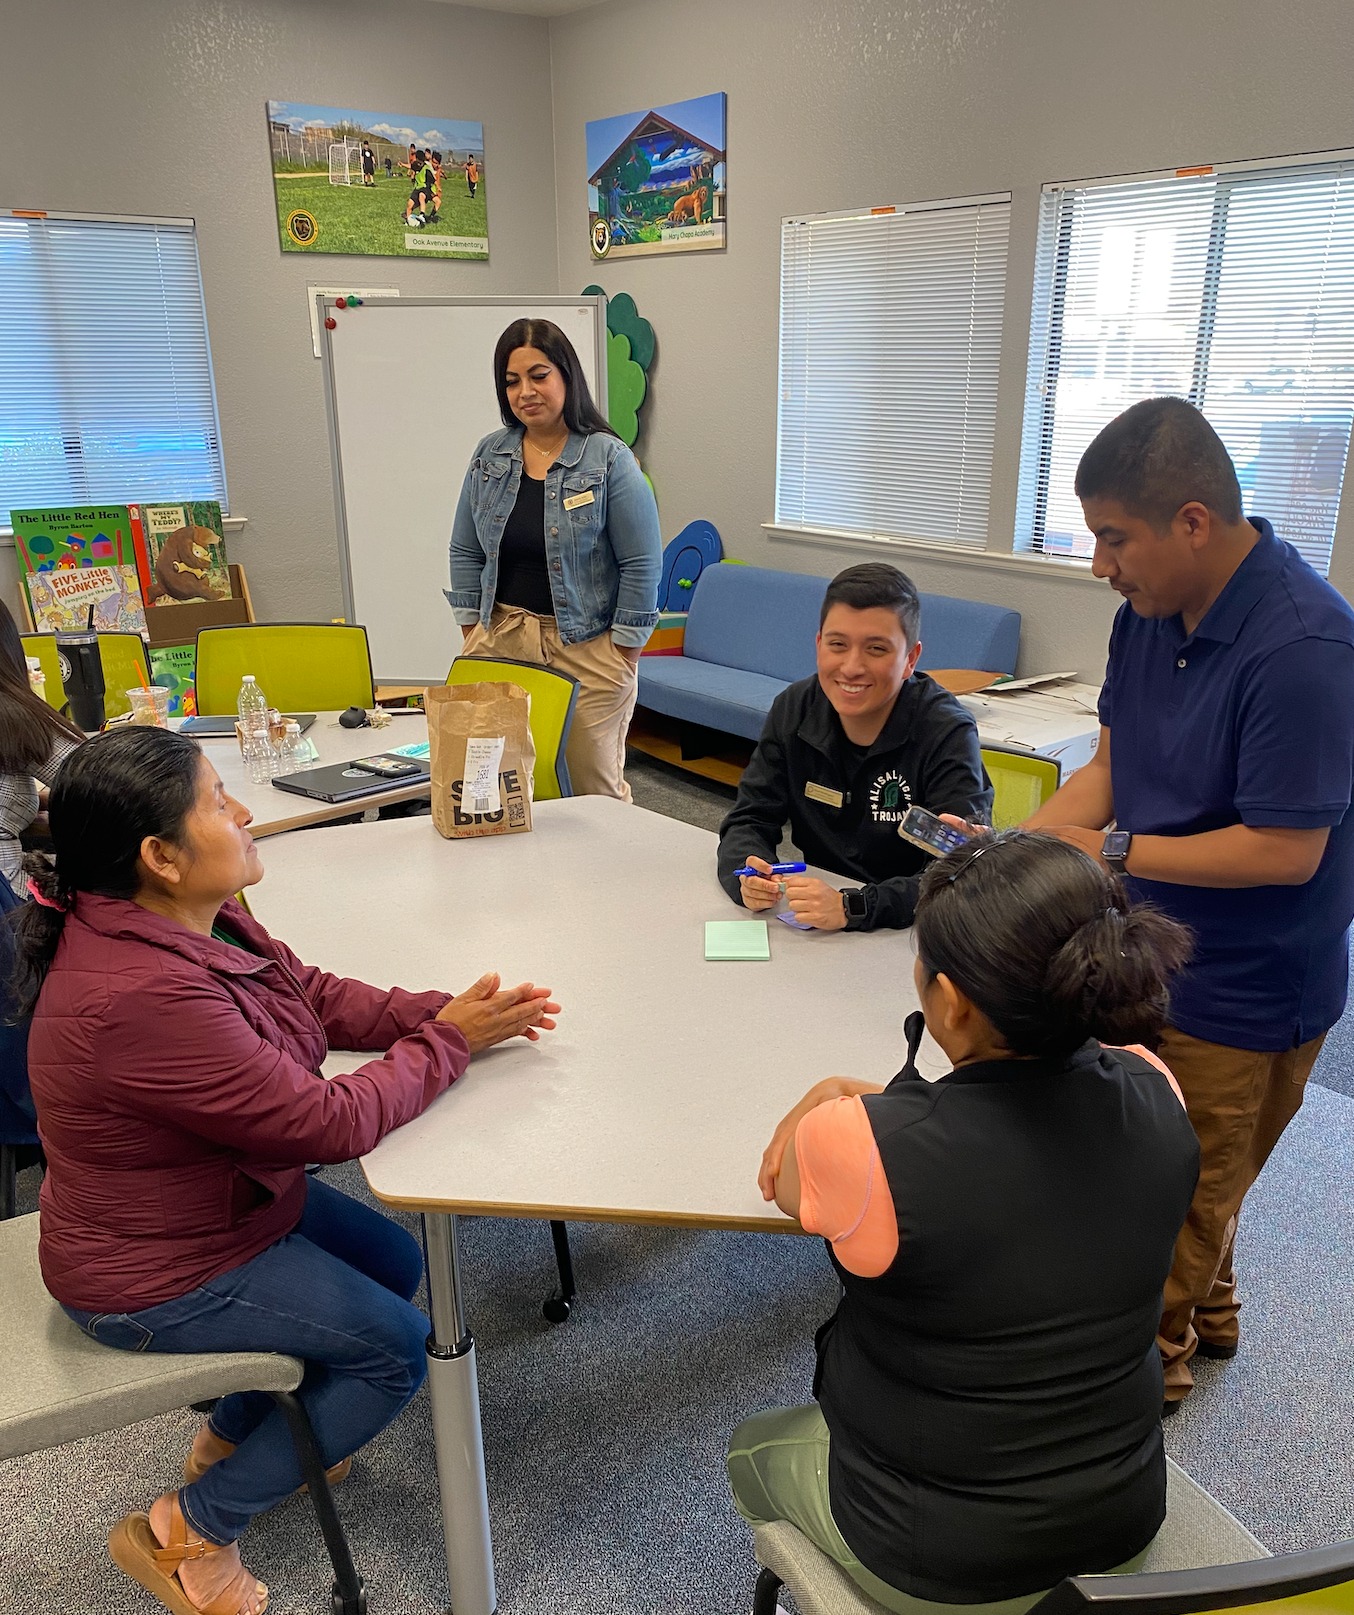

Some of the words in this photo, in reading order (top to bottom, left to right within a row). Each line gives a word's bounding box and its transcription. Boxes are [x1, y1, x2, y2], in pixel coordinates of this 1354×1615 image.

[680, 231, 694, 239] Chapa
[694, 229, 715, 237] Academy
[412, 238, 425, 246] Oak
[426, 239, 449, 247] Avenue
[449, 240, 484, 250] Elementary
[17, 515, 39, 523] The
[41, 513, 72, 523] Little
[74, 512, 96, 521] Red
[98, 511, 120, 520] Hen
[151, 518, 182, 526] TEDDY?
[51, 572, 80, 589] FIVE
[80, 568, 109, 581] Little
[56, 575, 113, 599] MONKEYS
[150, 655, 163, 663] he
[165, 651, 193, 661] Little
[451, 769, 521, 802] SE
[869, 769, 898, 802] ALISAL
[453, 804, 504, 826] BIG
